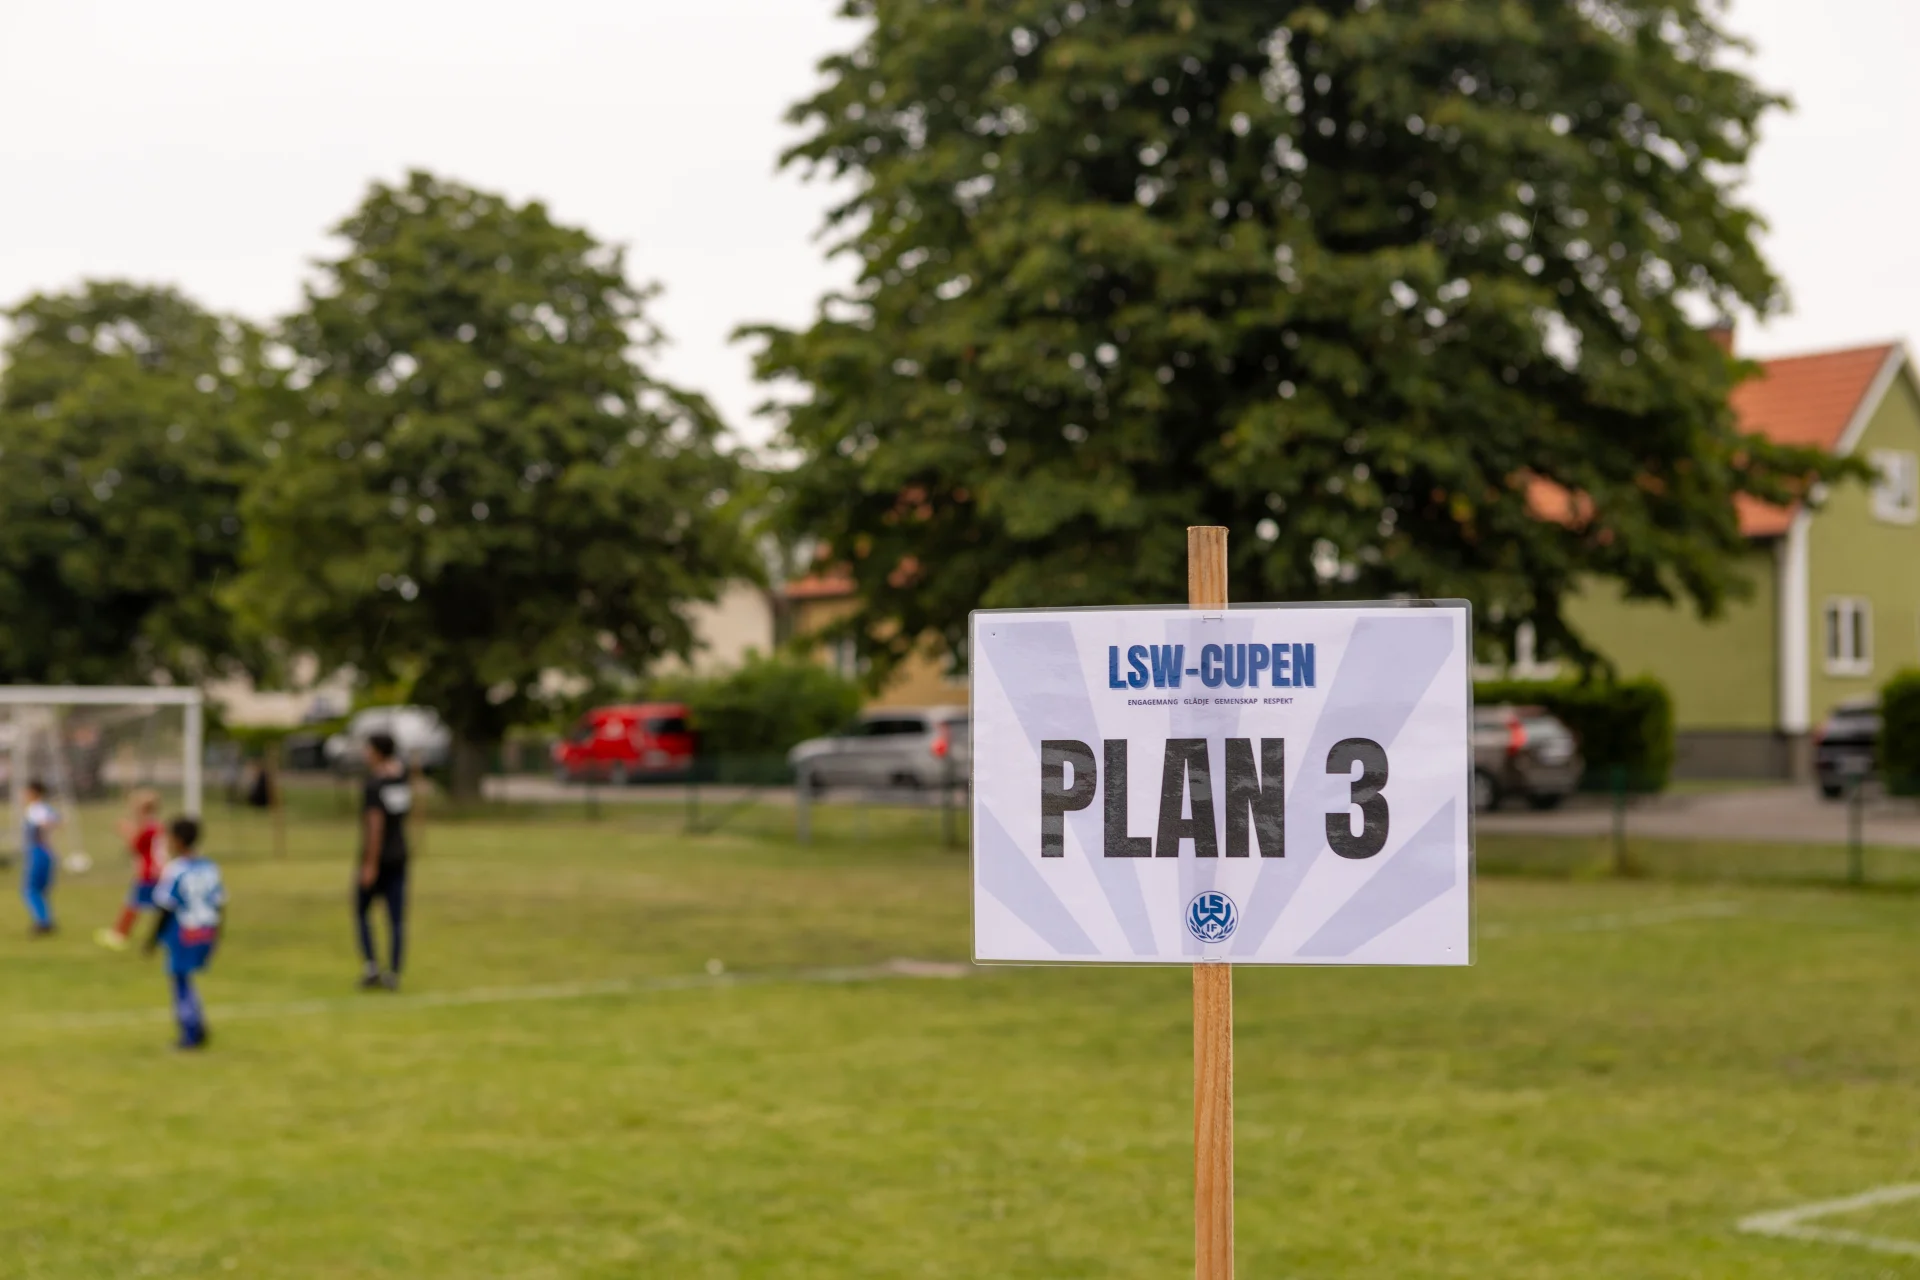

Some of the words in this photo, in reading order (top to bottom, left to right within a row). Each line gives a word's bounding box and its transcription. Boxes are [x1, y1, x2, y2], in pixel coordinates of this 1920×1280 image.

[1109, 643, 1316, 689] LSW-CUPEN
[1127, 698, 1179, 706] ENGAGEMANG
[1263, 697, 1294, 705] RESPEKT
[1041, 738, 1285, 858] PLAN
[1325, 738, 1389, 859] 3
